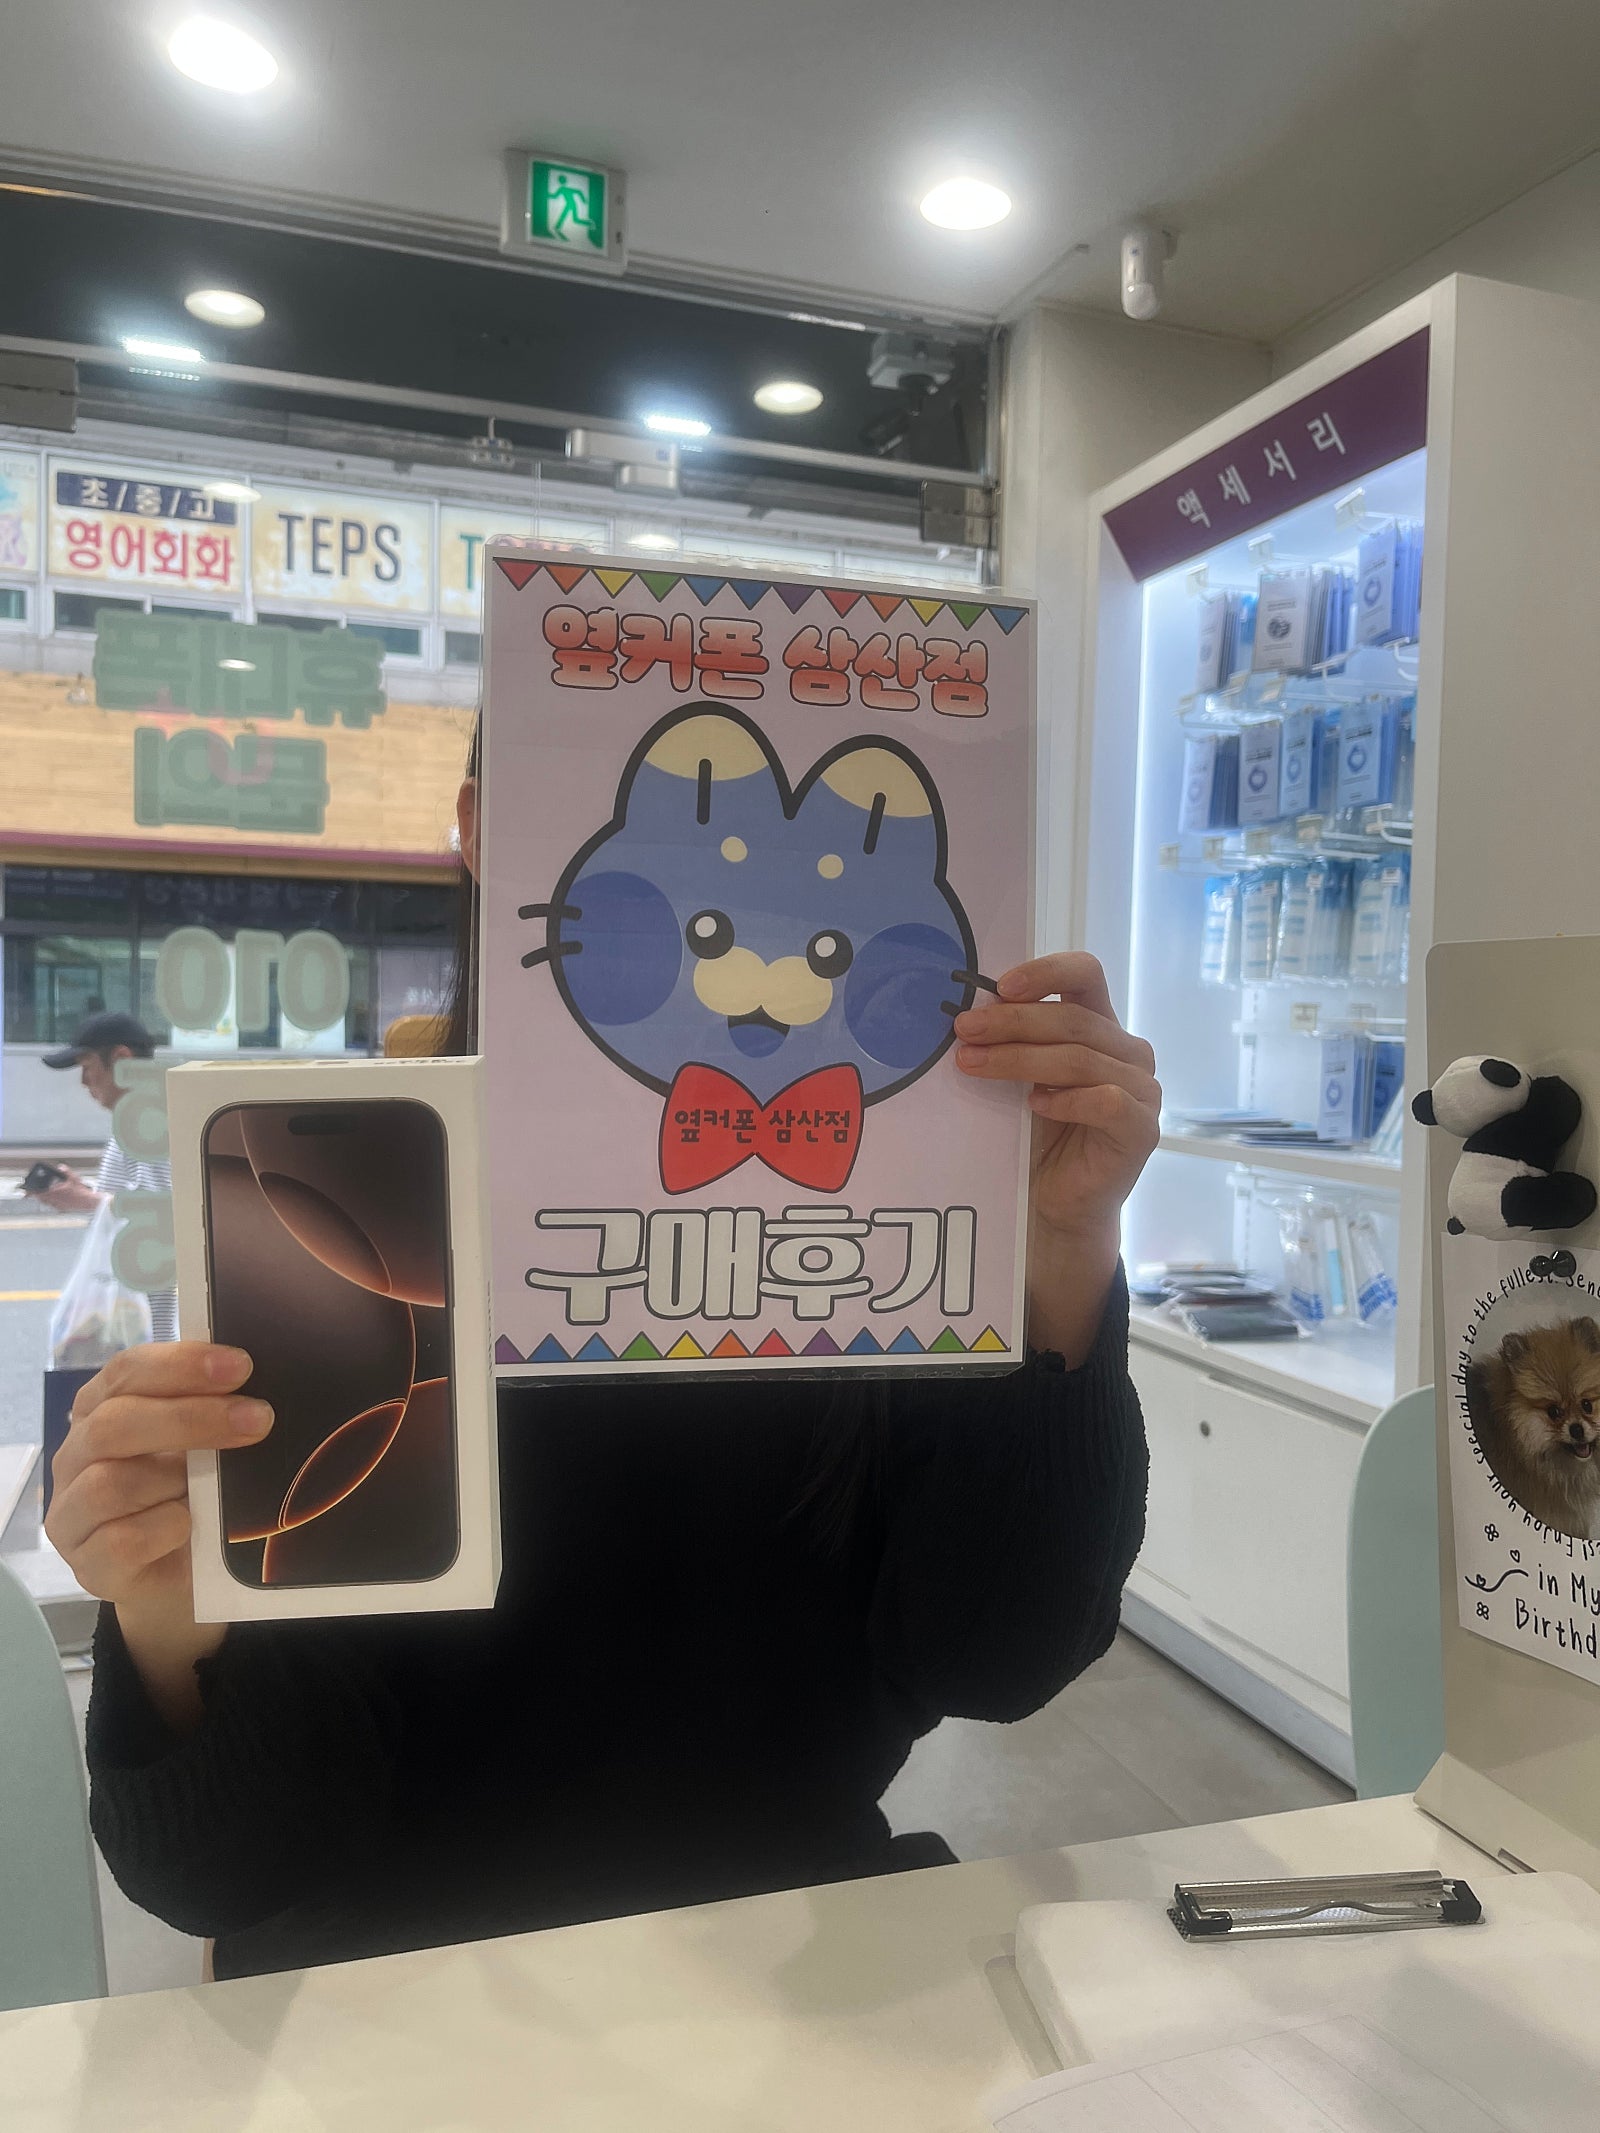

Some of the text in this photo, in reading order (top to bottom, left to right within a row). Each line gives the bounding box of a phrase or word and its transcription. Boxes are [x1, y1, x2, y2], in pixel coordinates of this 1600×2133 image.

[1176, 412, 1346, 528] 액세서리
[66, 518, 234, 585] 영어회화
[277, 512, 401, 584] TEPS
[542, 603, 989, 718] 옆커폰 삼산점
[674, 1108, 851, 1143] 옆커폰 삼산점
[525, 1204, 977, 1326] 구매후기
[1462, 1324, 1477, 1345] to
[1474, 1291, 1498, 1321] the
[1451, 1350, 1472, 1386] day
[1455, 1394, 1485, 1464] special
[1487, 1472, 1517, 1513] your
[1523, 1511, 1573, 1557] Enjoy
[1538, 1563, 1600, 1615] in My
[1516, 1597, 1597, 1659] Birthd
